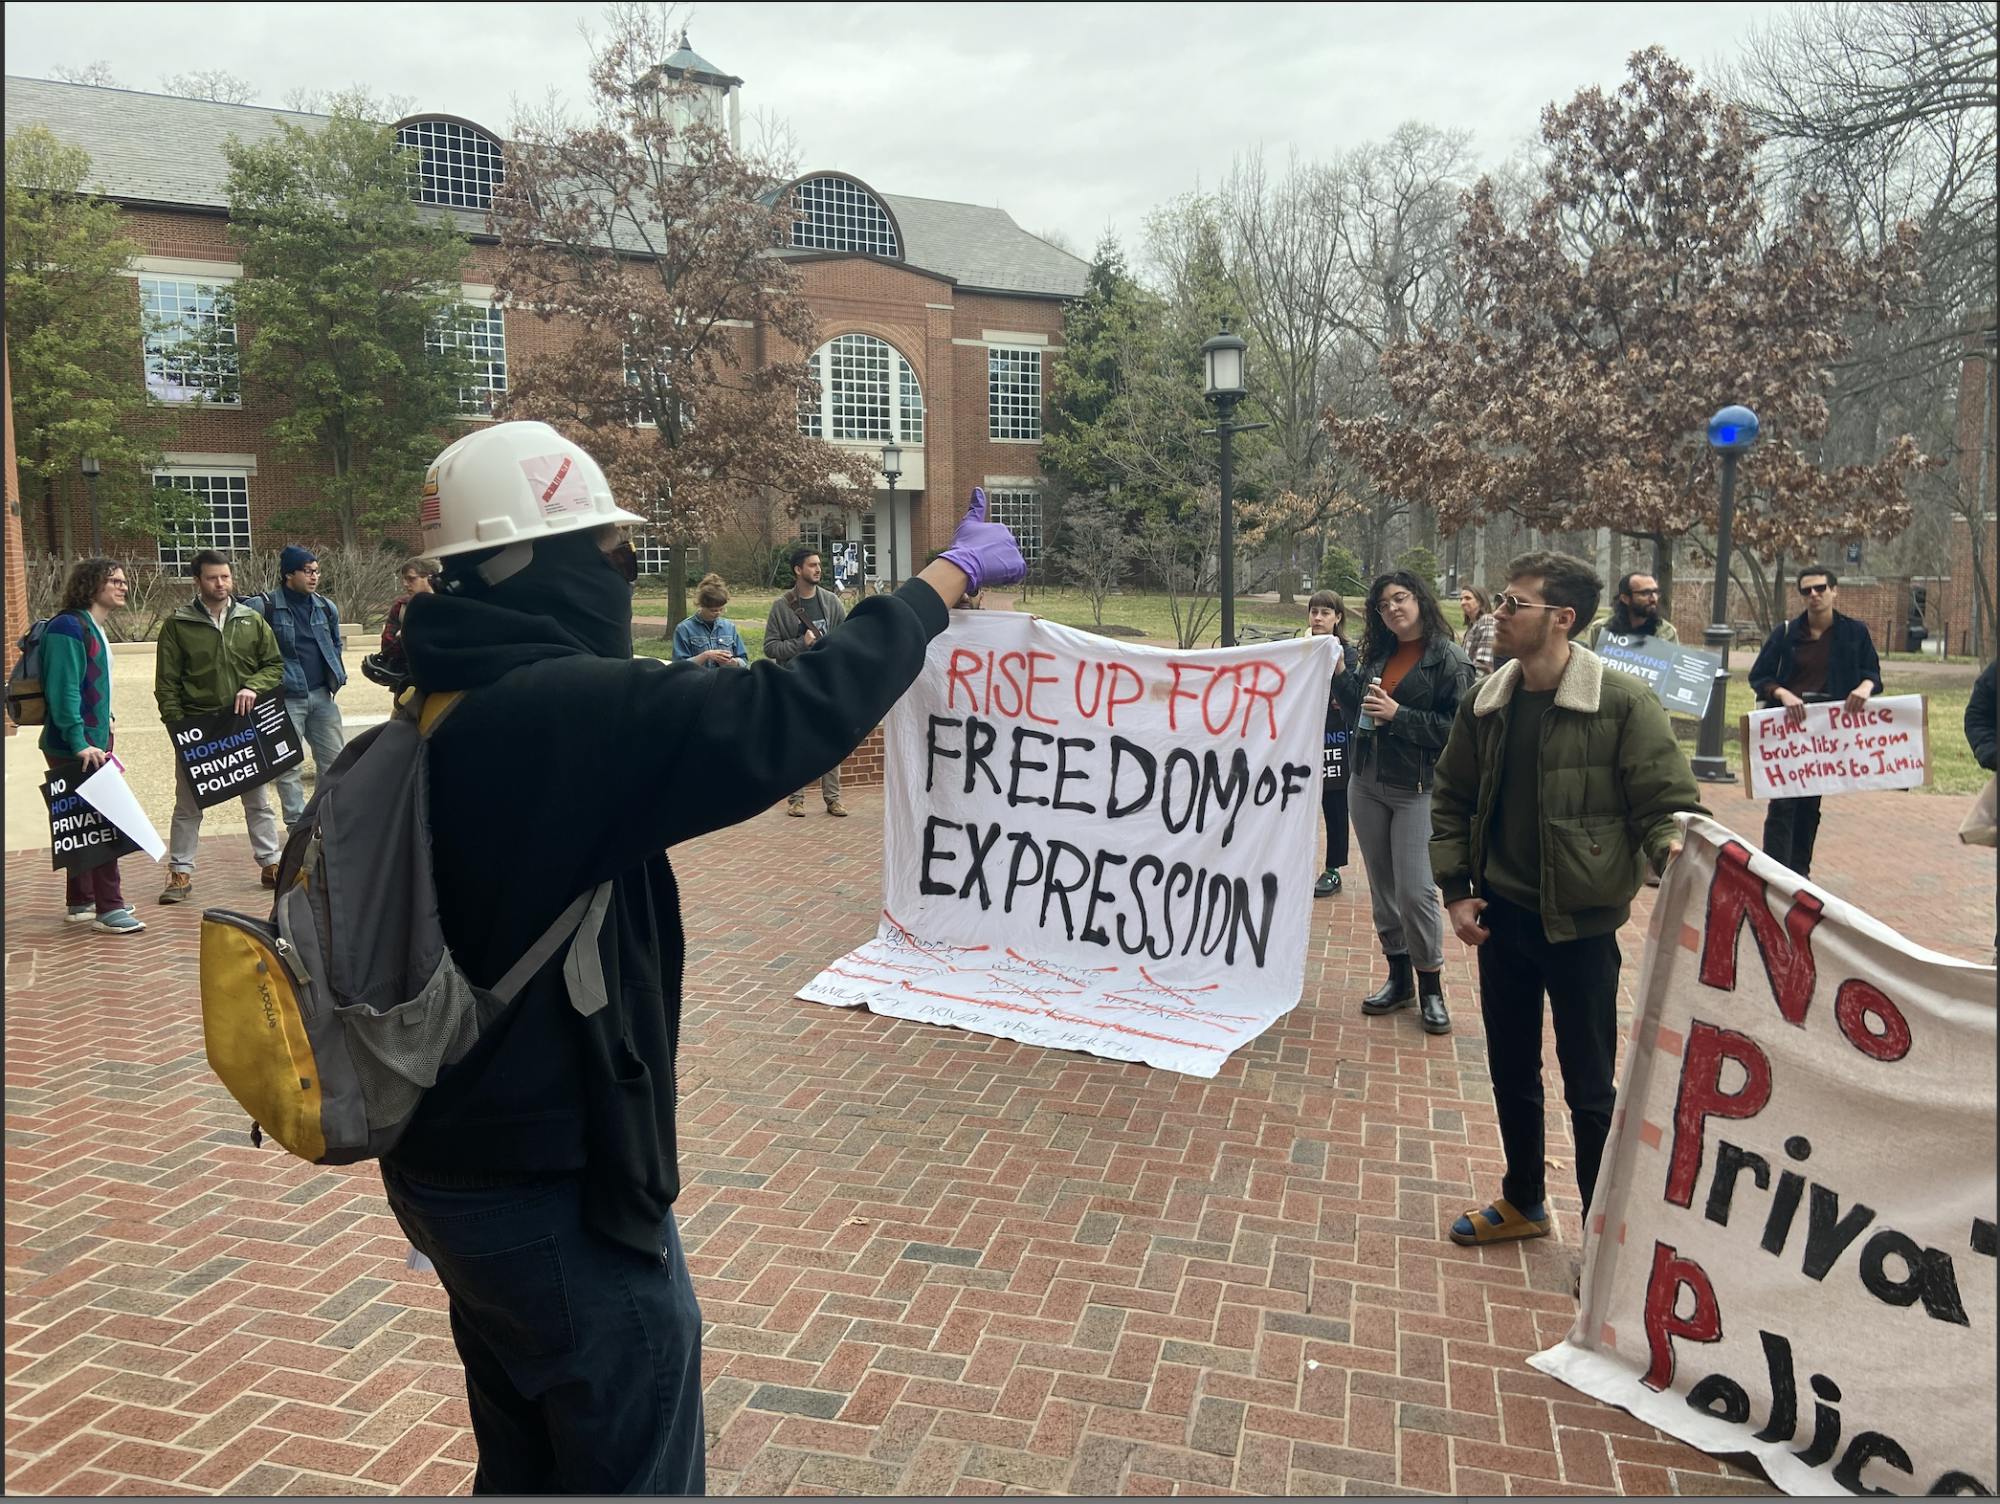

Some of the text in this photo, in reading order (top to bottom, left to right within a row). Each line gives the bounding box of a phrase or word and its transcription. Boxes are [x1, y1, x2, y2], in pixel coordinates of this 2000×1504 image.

[1608, 632, 1629, 646] NO
[1599, 656, 1659, 681] PRIVATE
[1603, 645, 1669, 670] HOPKINS
[946, 648, 1287, 740] RISE UP FOR
[1828, 707, 1893, 730] Police
[176, 728, 203, 746] NO
[183, 728, 256, 762] HOPKINS
[1854, 731, 1908, 750] from
[190, 745, 256, 779] PRIVATE
[1764, 758, 1847, 789] Hopkins
[1850, 757, 1869, 777] to
[50, 779, 67, 796] NO
[196, 762, 259, 796] POLICE!
[926, 714, 1312, 848] FREEDOM OF
[51, 796, 84, 815] HOP
[52, 811, 104, 835] PRIVAT
[54, 827, 119, 855] POLICE!
[920, 815, 1278, 968] EXPRESSION
[1698, 838, 1913, 1062] No
[257, 983, 277, 1029] embark
